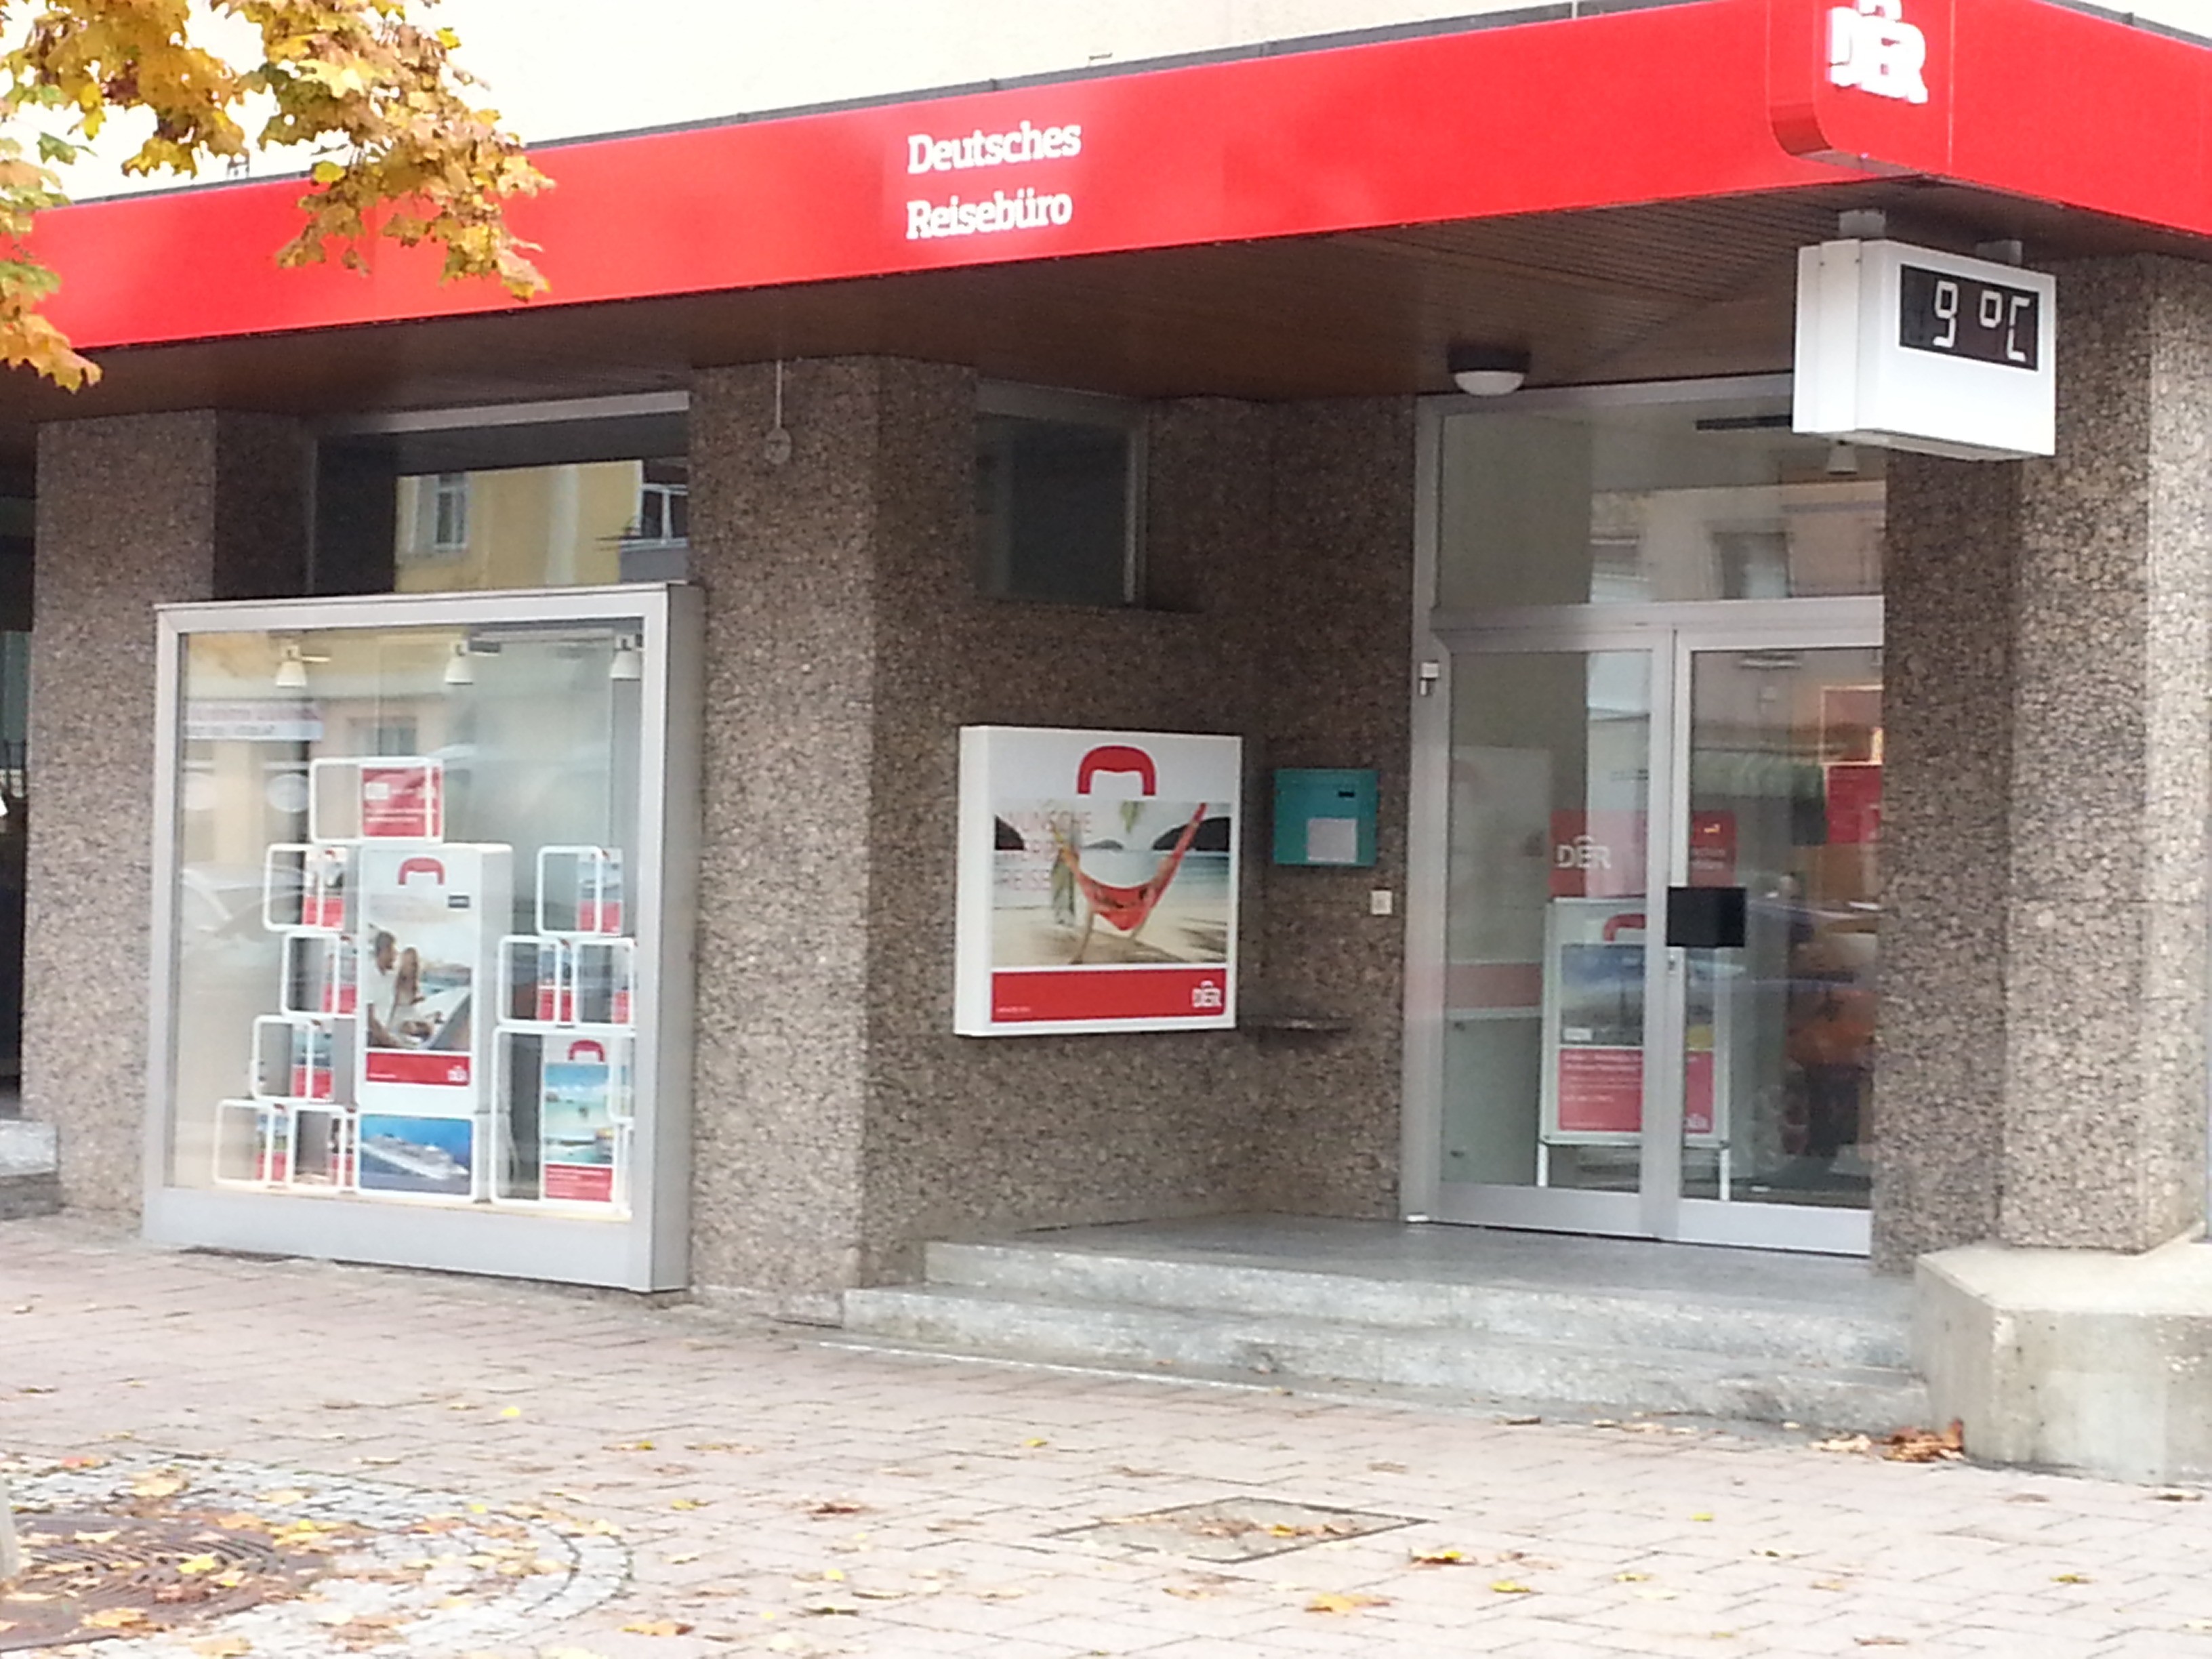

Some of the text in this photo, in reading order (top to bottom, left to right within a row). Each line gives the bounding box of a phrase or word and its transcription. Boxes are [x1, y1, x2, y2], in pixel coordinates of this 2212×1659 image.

[907, 120, 1082, 174] Deutsches
[906, 187, 1073, 240] Reisebüro
[1933, 280, 1959, 348] 9
[1554, 844, 1612, 869] DER
